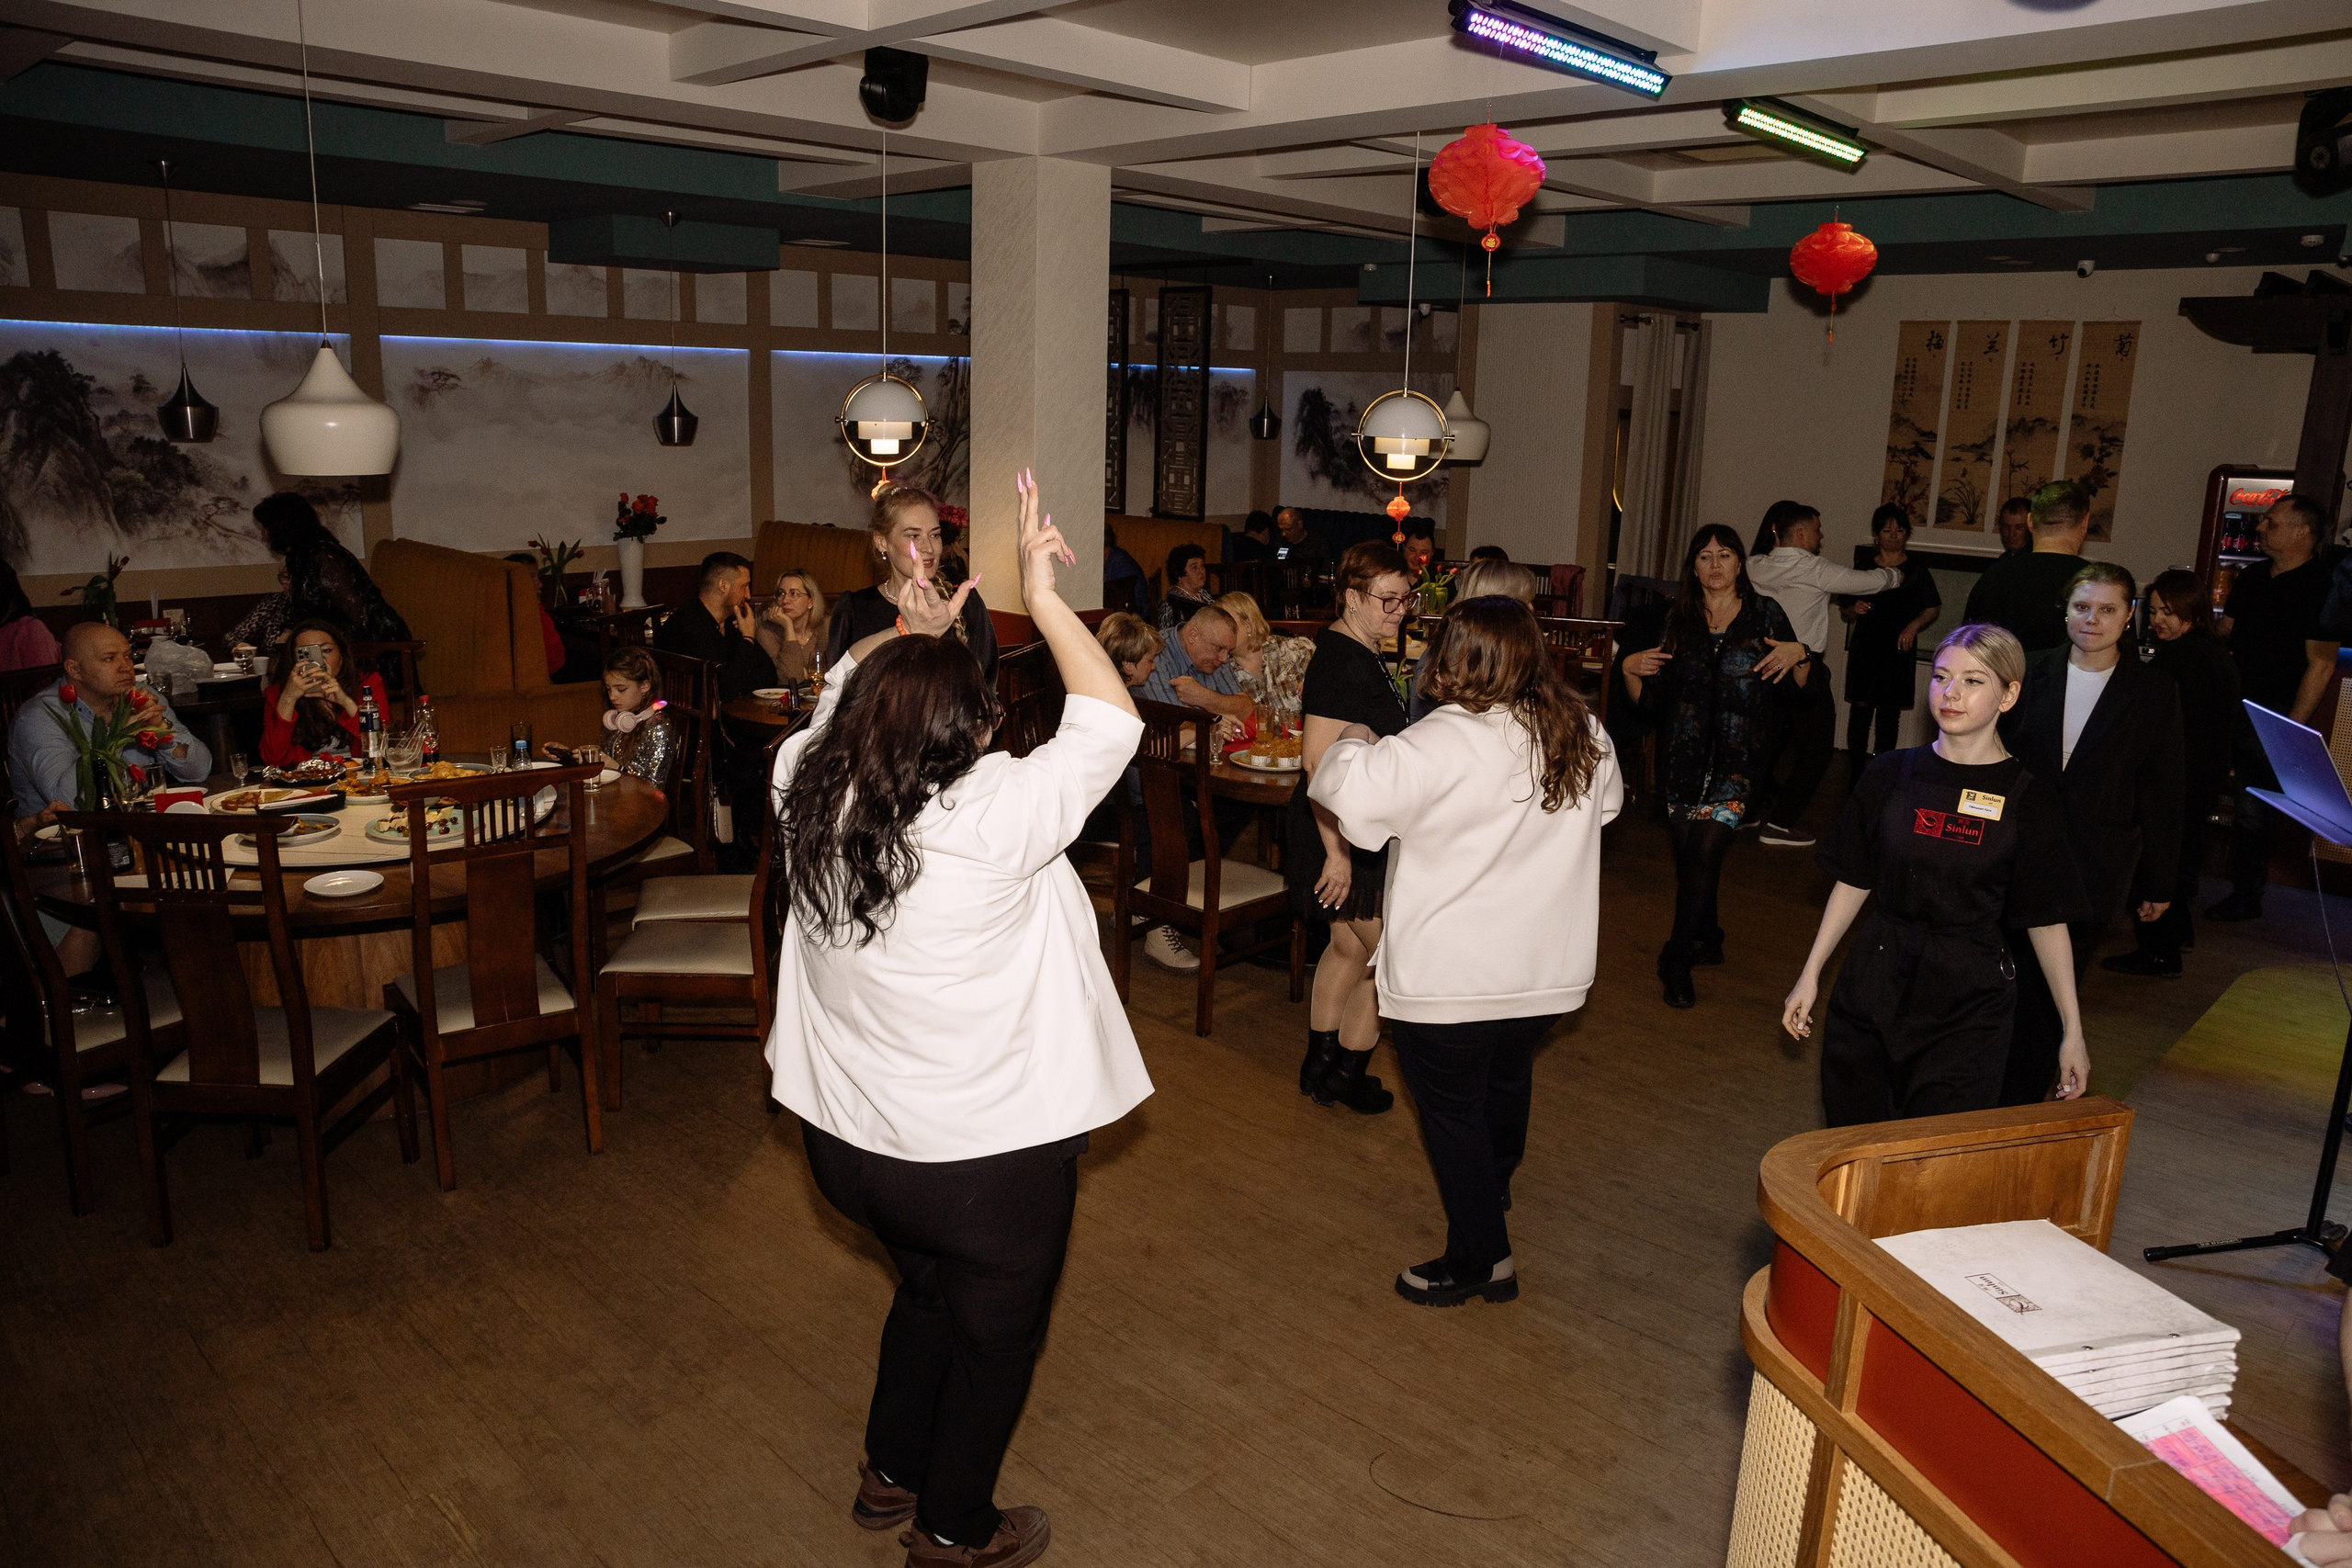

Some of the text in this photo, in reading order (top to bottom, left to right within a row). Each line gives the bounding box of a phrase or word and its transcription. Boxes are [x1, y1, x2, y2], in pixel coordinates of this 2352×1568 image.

[1926, 330, 1945, 352] 梅
[2049, 333, 2070, 355] 竹
[1982, 795, 2001, 804] Sinlun
[1945, 823, 1979, 836] Sinlun
[1980, 1276, 2008, 1294] Sinlun
